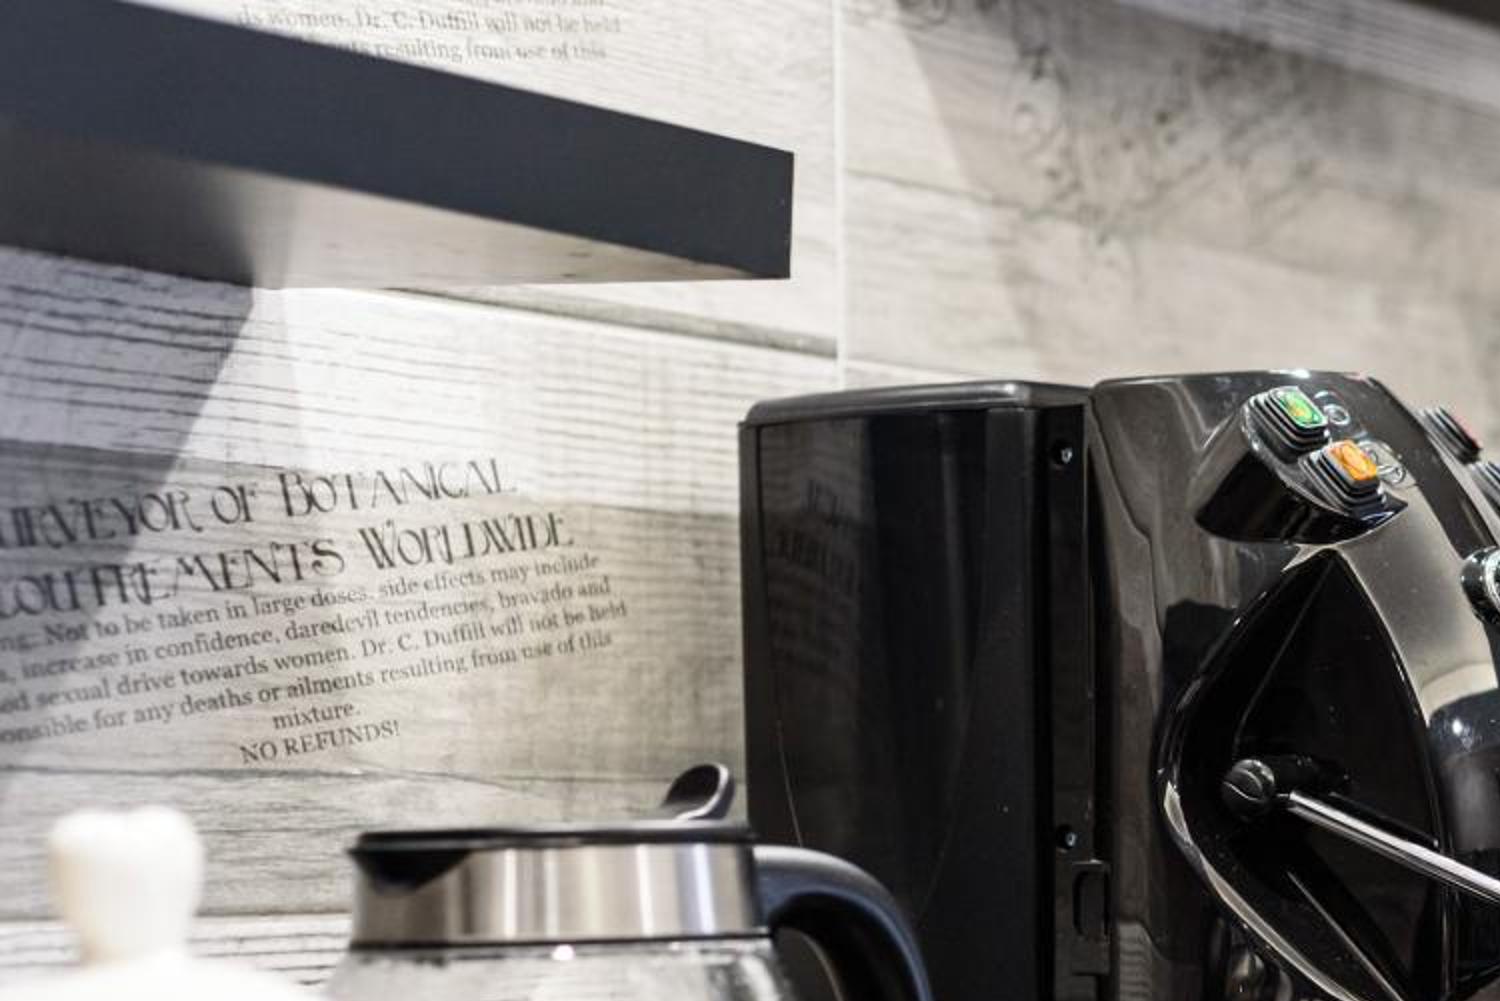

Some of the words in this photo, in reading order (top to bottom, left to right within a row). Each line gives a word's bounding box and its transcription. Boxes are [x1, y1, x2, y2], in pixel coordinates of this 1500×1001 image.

[212, 485, 258, 524] OF
[278, 459, 517, 518] BOTANICAL
[359, 511, 574, 570] WORLDWIDE
[22, 649, 121, 679] increase
[126, 642, 149, 663] in
[285, 609, 380, 641] daredevil
[498, 582, 573, 609] bravado
[577, 575, 611, 597] and
[95, 620, 120, 637] to
[125, 613, 153, 635] be
[158, 607, 220, 631] taken
[225, 600, 248, 619] in
[253, 597, 306, 617] large
[380, 576, 418, 597] side
[423, 570, 486, 591] effects
[490, 565, 529, 583] may
[534, 552, 599, 577] include
[37, 677, 111, 709] sexual
[117, 672, 177, 696] drive
[180, 656, 269, 686] towards
[424, 621, 486, 648] Duffill
[490, 613, 525, 638] will
[529, 611, 559, 631] not
[563, 607, 586, 625] be
[588, 599, 628, 622] held
[93, 708, 127, 731] for
[133, 702, 175, 725] any
[179, 687, 254, 717] deaths
[258, 685, 283, 703] or
[288, 671, 375, 699] ailments
[380, 654, 468, 683] resulting
[471, 648, 519, 669] from
[521, 642, 552, 660] use
[556, 637, 576, 654] of
[578, 629, 613, 650] this
[240, 741, 278, 764] NO
[284, 720, 400, 757] REFUNDS!
